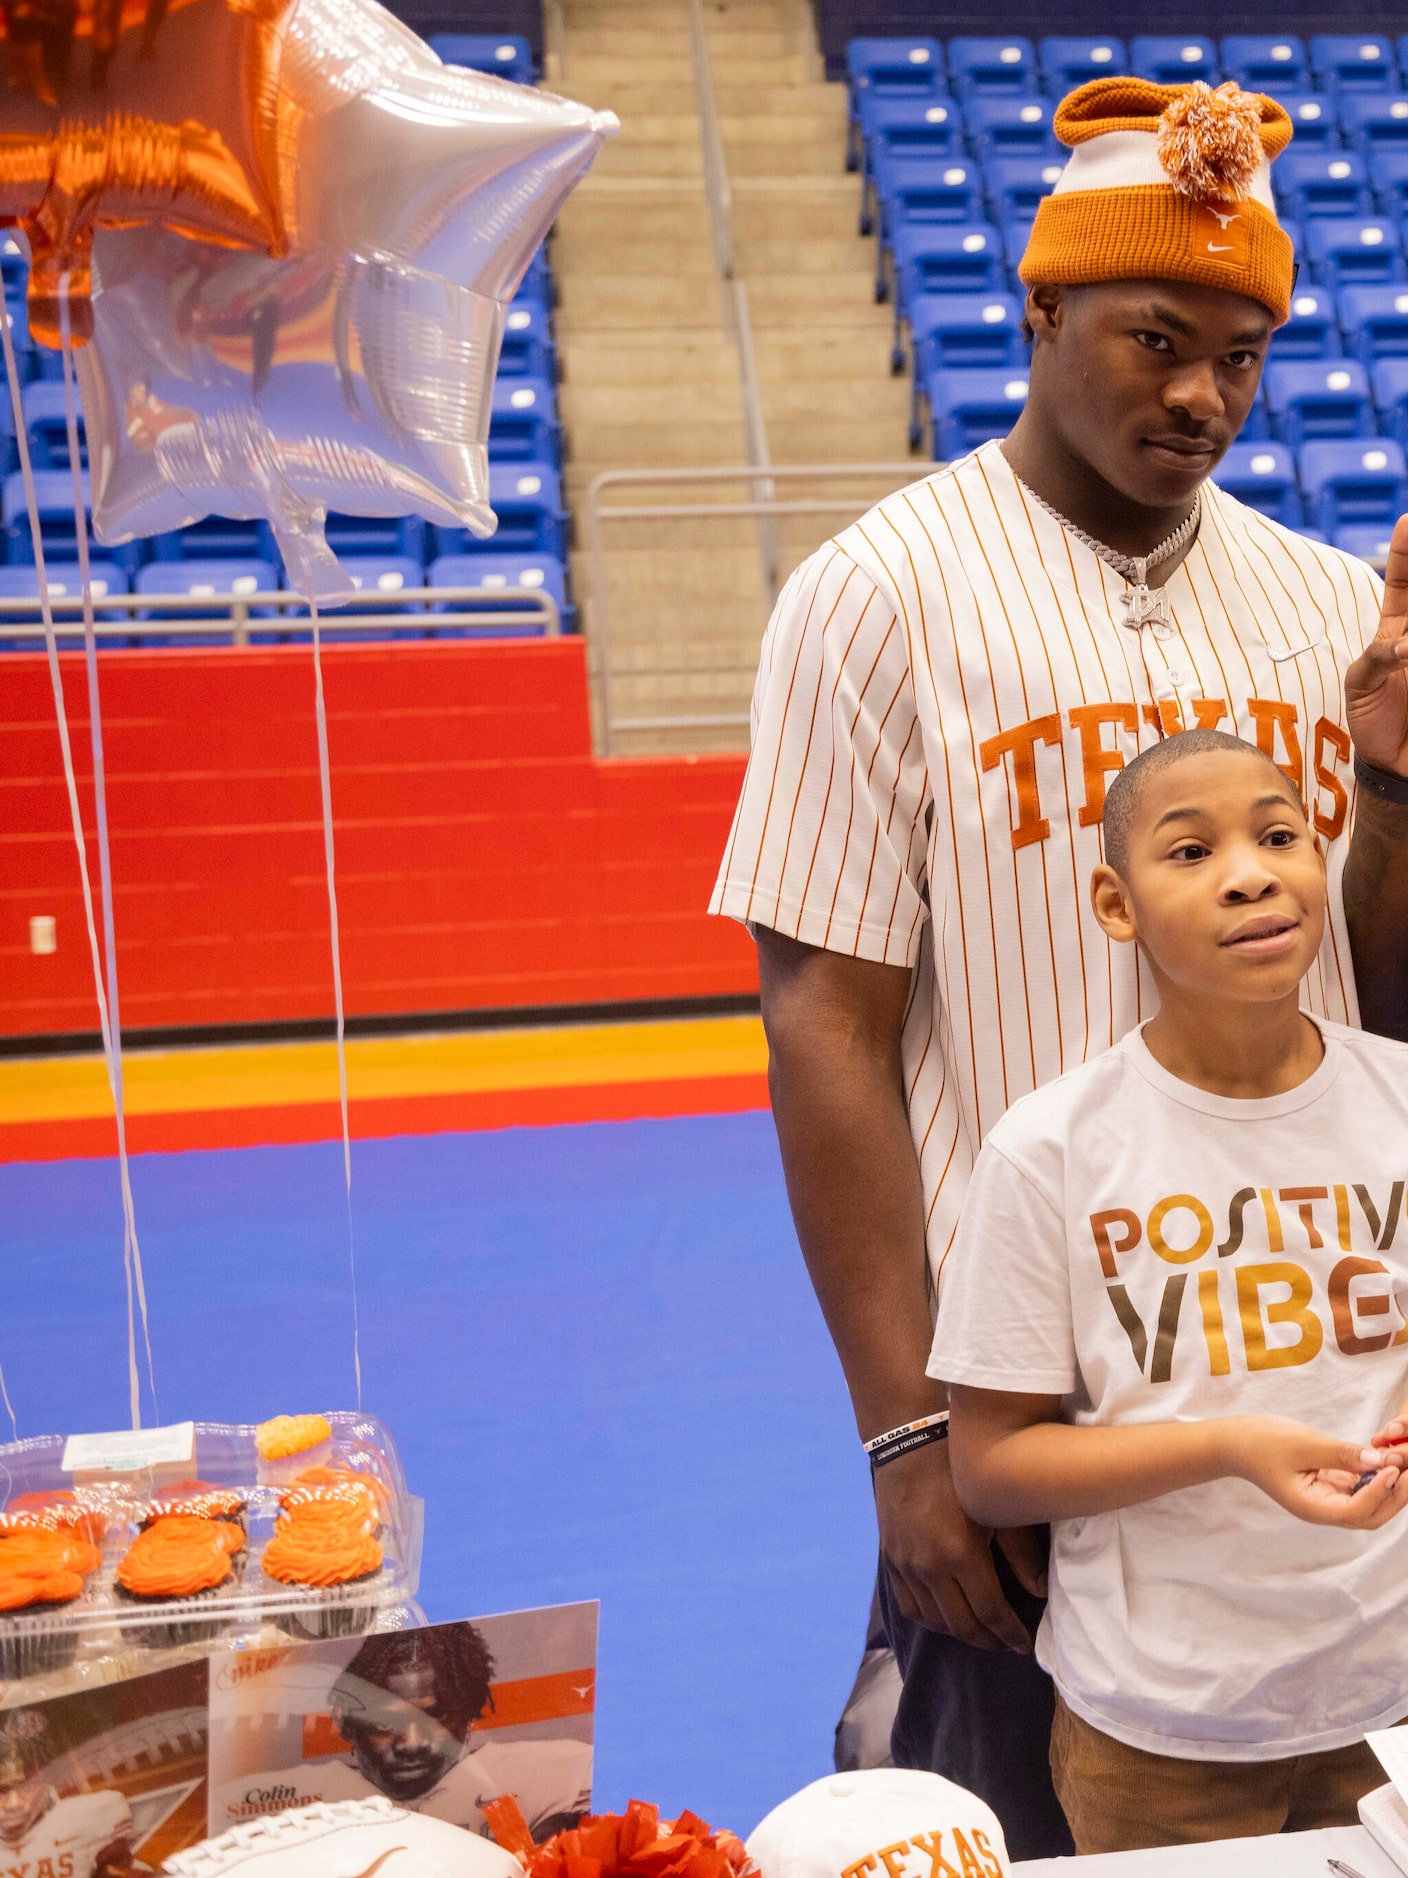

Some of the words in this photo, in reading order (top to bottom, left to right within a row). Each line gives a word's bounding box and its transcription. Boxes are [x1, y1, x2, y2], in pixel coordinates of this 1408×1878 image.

[872, 1438, 887, 1448] ALL
[888, 1426, 910, 1440] GAS
[900, 1432, 930, 1450] FOOTBALL
[227, 1792, 323, 1817] Simmons
[245, 1784, 296, 1804] Colin
